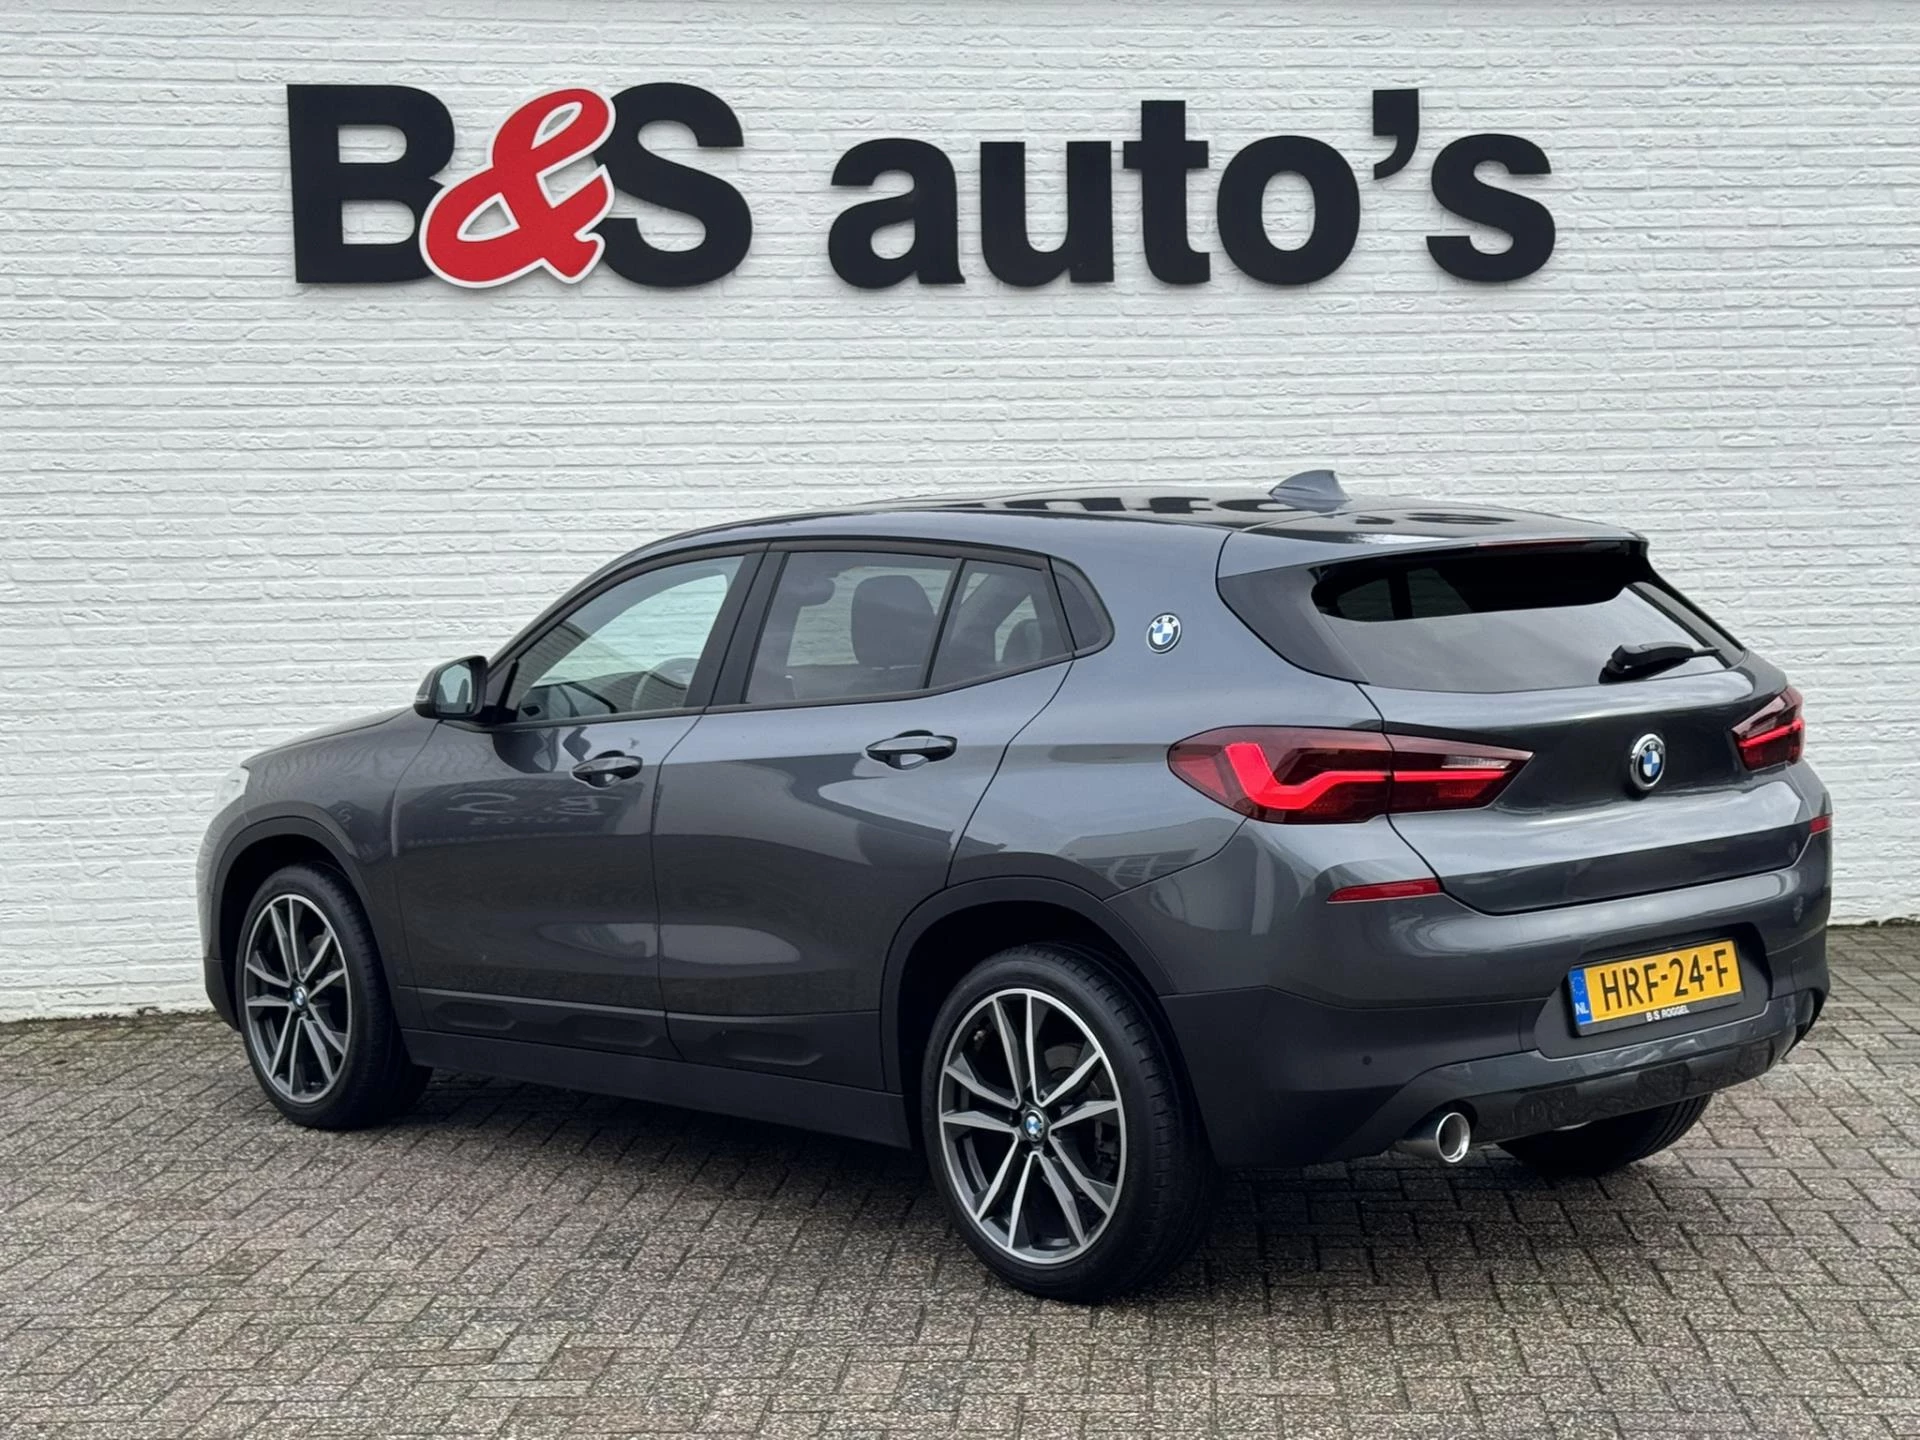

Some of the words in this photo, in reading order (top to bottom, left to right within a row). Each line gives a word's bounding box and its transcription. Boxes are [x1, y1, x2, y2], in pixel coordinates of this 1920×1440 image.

[287, 83, 752, 288] B&S
[827, 88, 1556, 289] auto's
[1575, 1002, 1589, 1014] NL
[1600, 949, 1728, 1011] HRF-24-F
